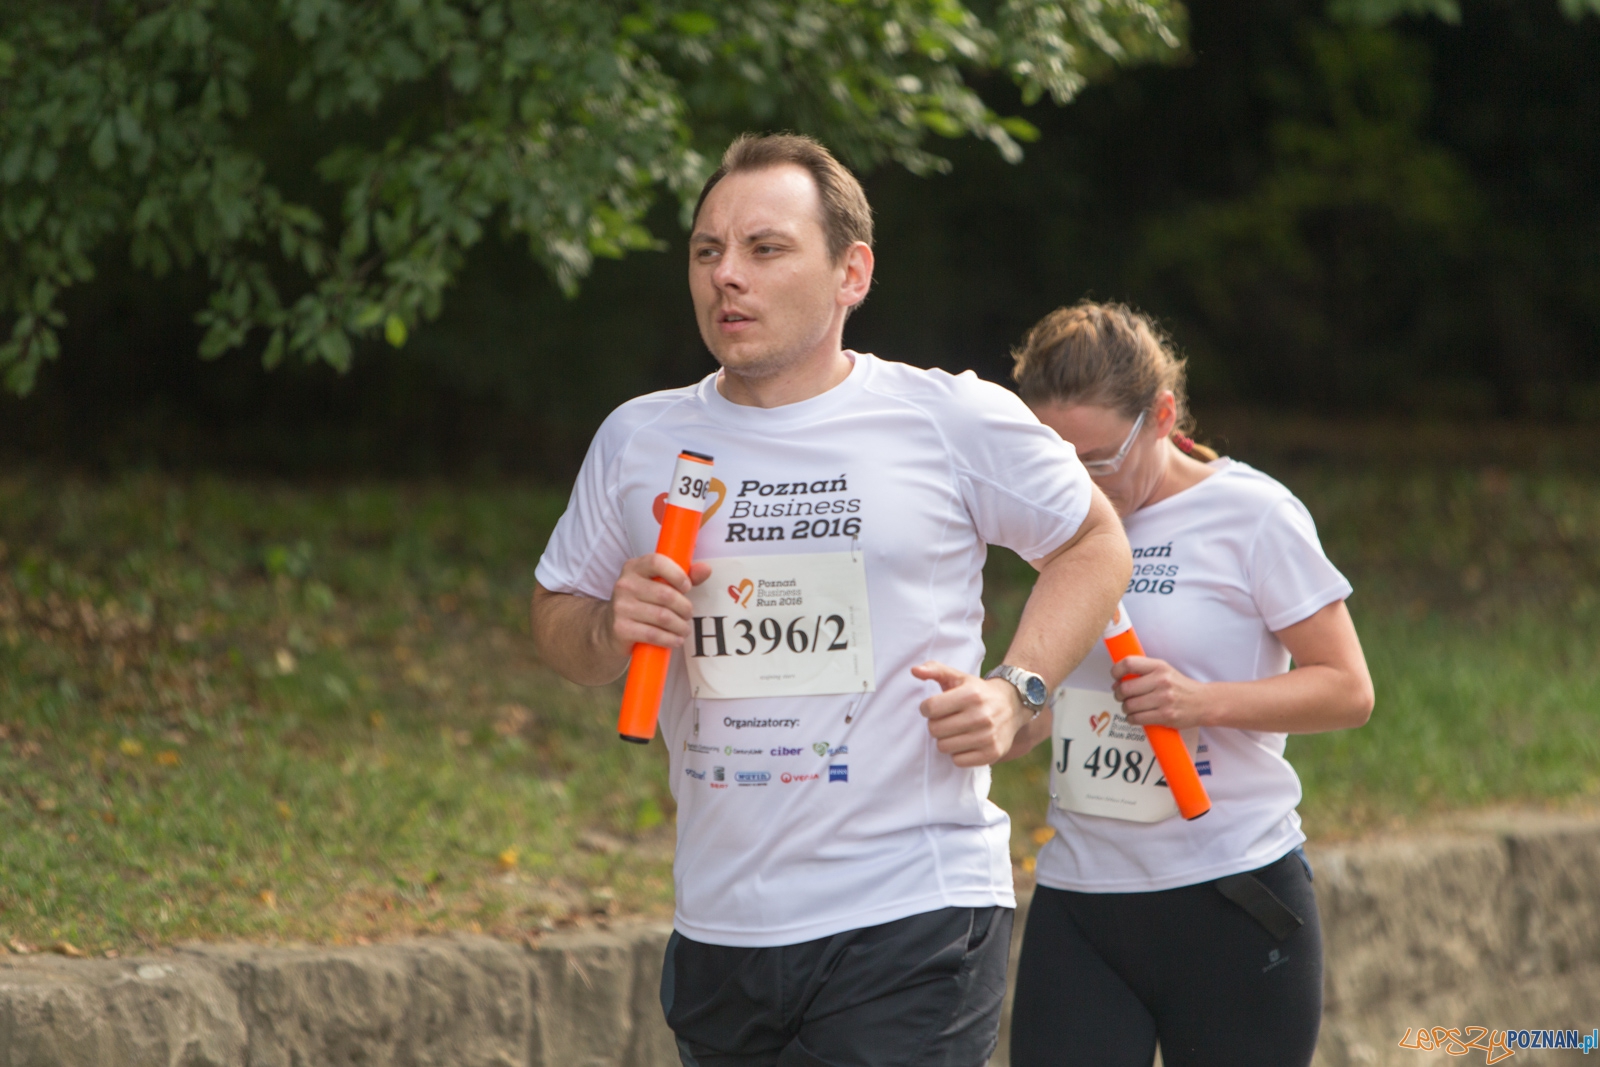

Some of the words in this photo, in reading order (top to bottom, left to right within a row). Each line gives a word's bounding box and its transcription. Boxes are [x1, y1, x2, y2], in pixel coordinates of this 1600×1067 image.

[737, 474, 847, 497] Poznań
[729, 499, 861, 519] Business
[725, 522, 784, 542] Run
[791, 517, 862, 540] 2016
[1132, 541, 1173, 559] nań
[758, 578, 796, 588] Poznań
[757, 588, 801, 597] Business
[756, 598, 777, 607] Run
[779, 597, 803, 606] 2016
[691, 614, 849, 658] H396/2
[723, 716, 800, 730] Organizatorzy:
[770, 746, 803, 756] ciber
[1056, 738, 1074, 774] J
